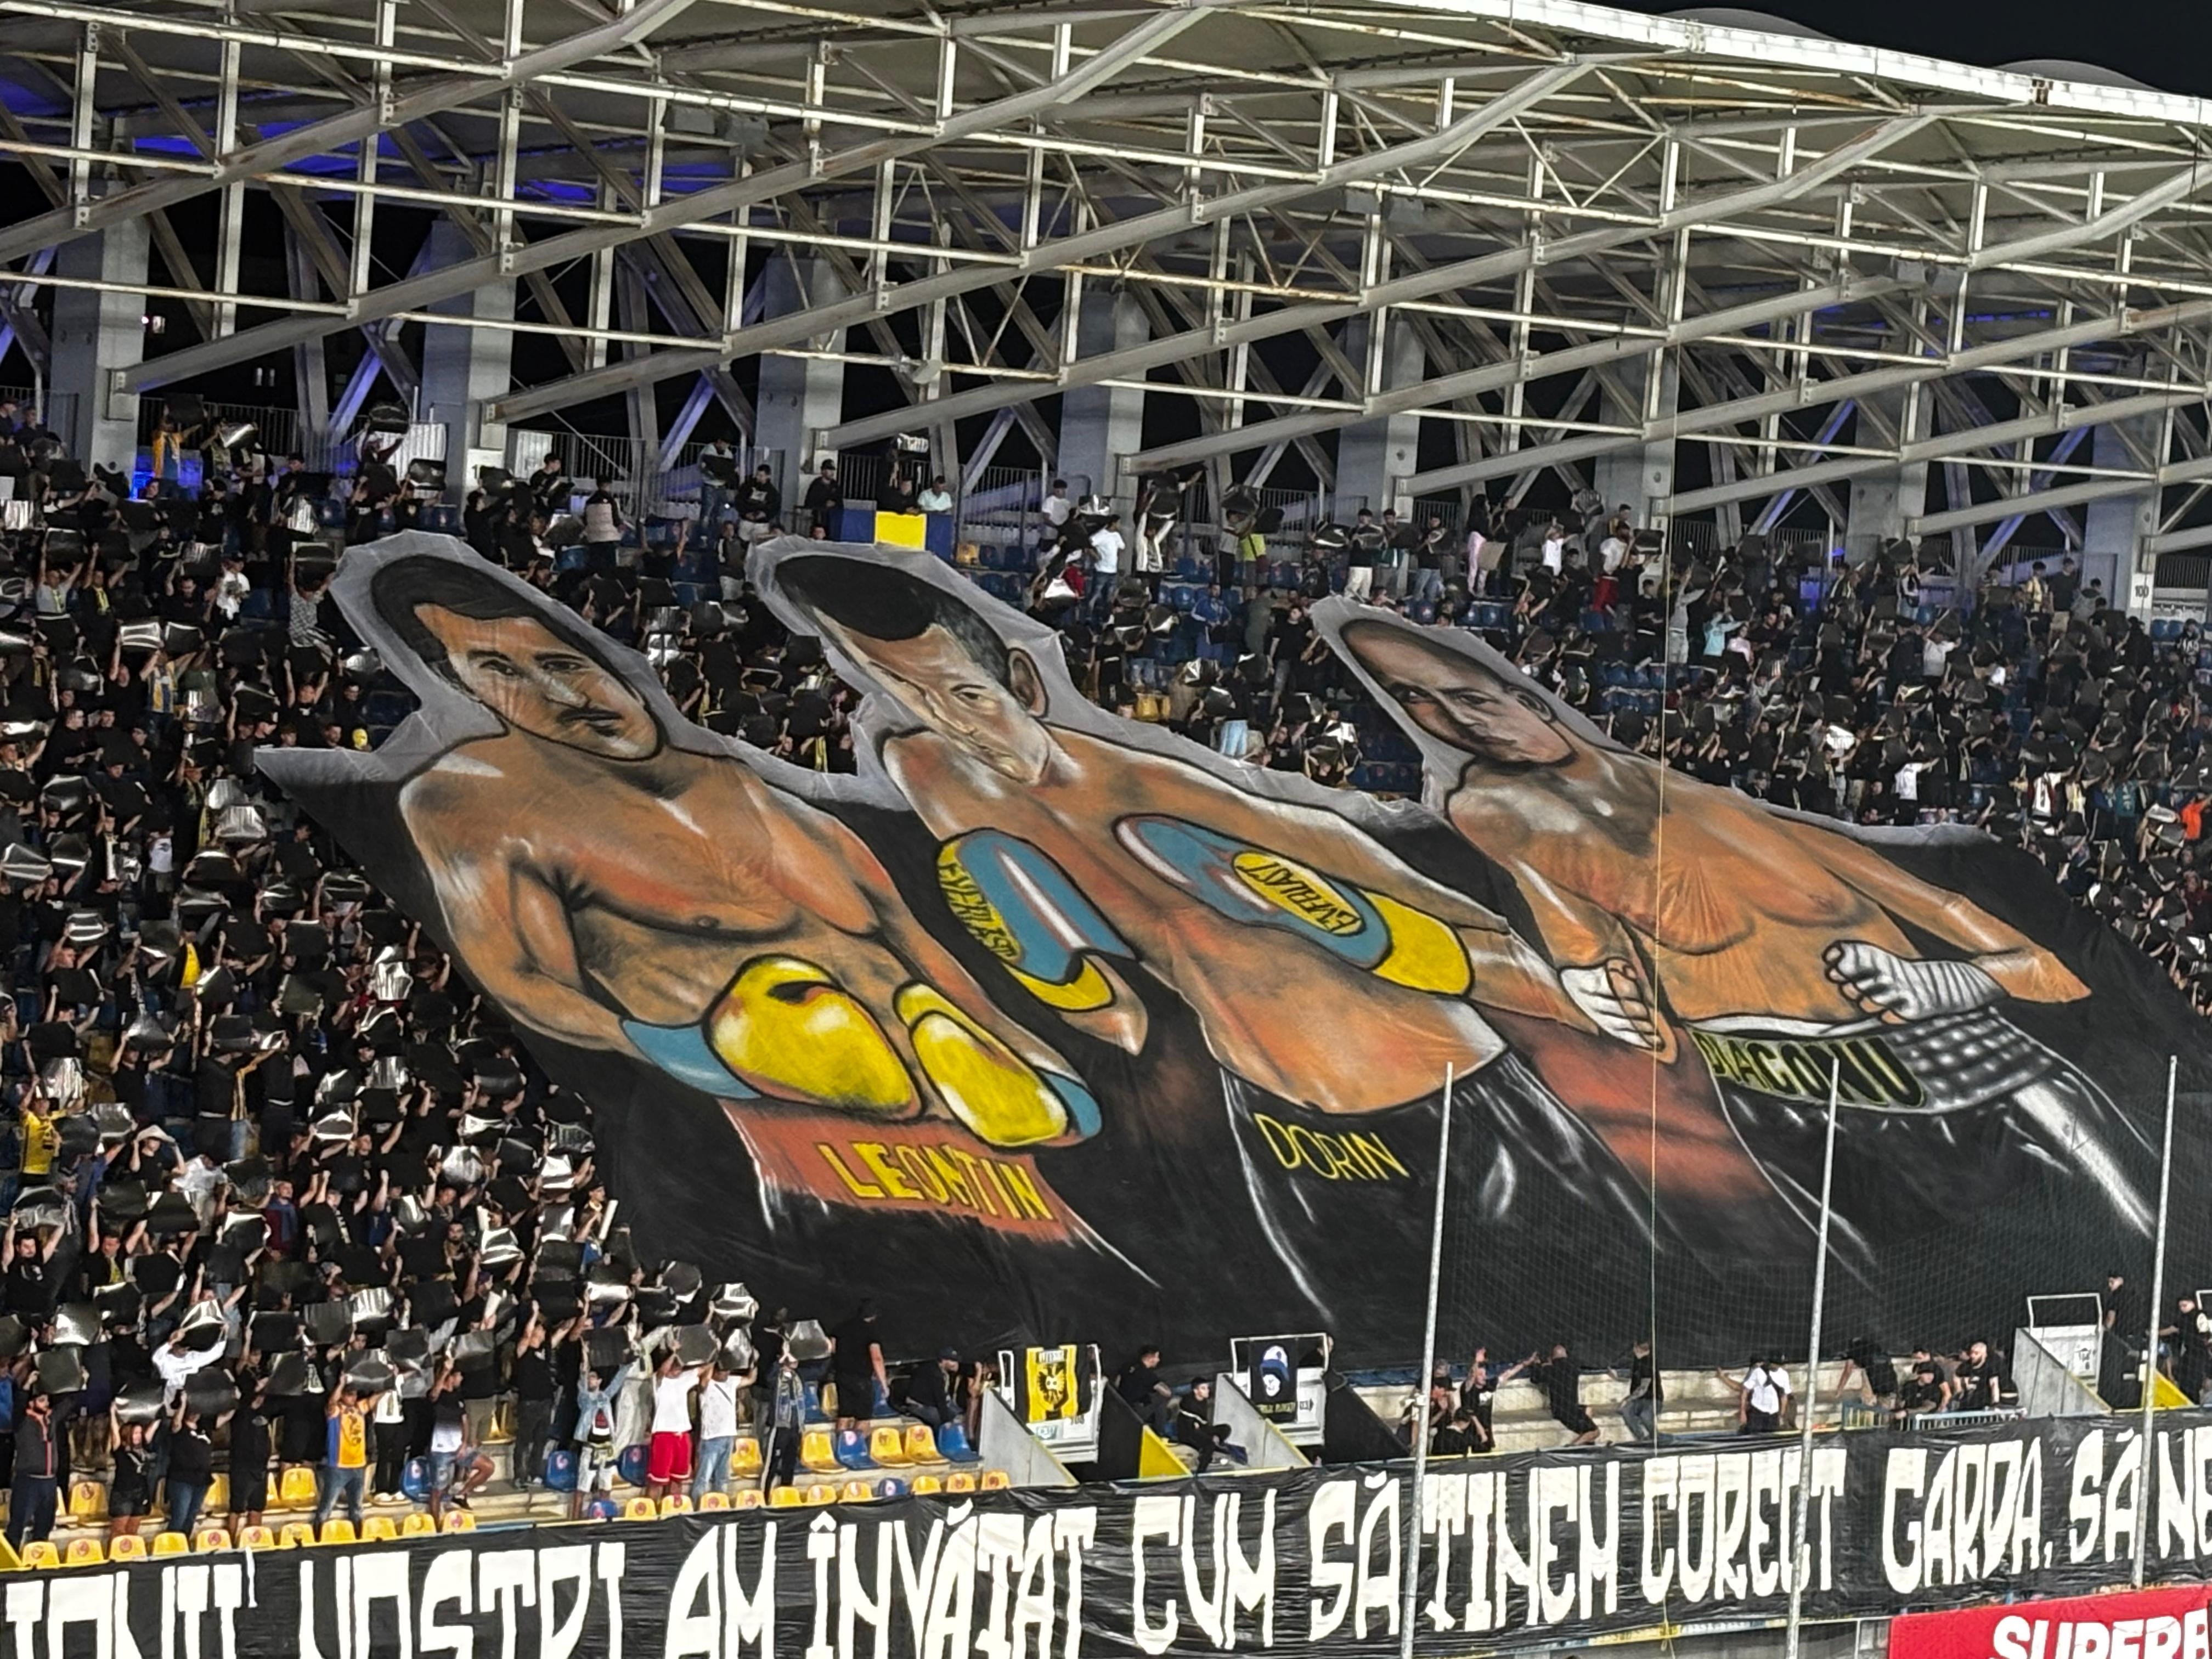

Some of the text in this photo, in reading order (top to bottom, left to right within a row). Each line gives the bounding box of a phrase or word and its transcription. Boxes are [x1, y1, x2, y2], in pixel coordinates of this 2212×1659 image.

[2135, 585, 2149, 598] 100
[1235, 862, 1361, 932] EVERLAST
[1692, 1031, 1924, 1107] DIACONU
[814, 1142, 1056, 1221] LEONTIN
[1253, 1112, 1410, 1181] DORIN
[665, 1522, 777, 1659] AM
[1132, 1489, 1277, 1655] CUM
[1640, 1448, 1847, 1604] CORECT
